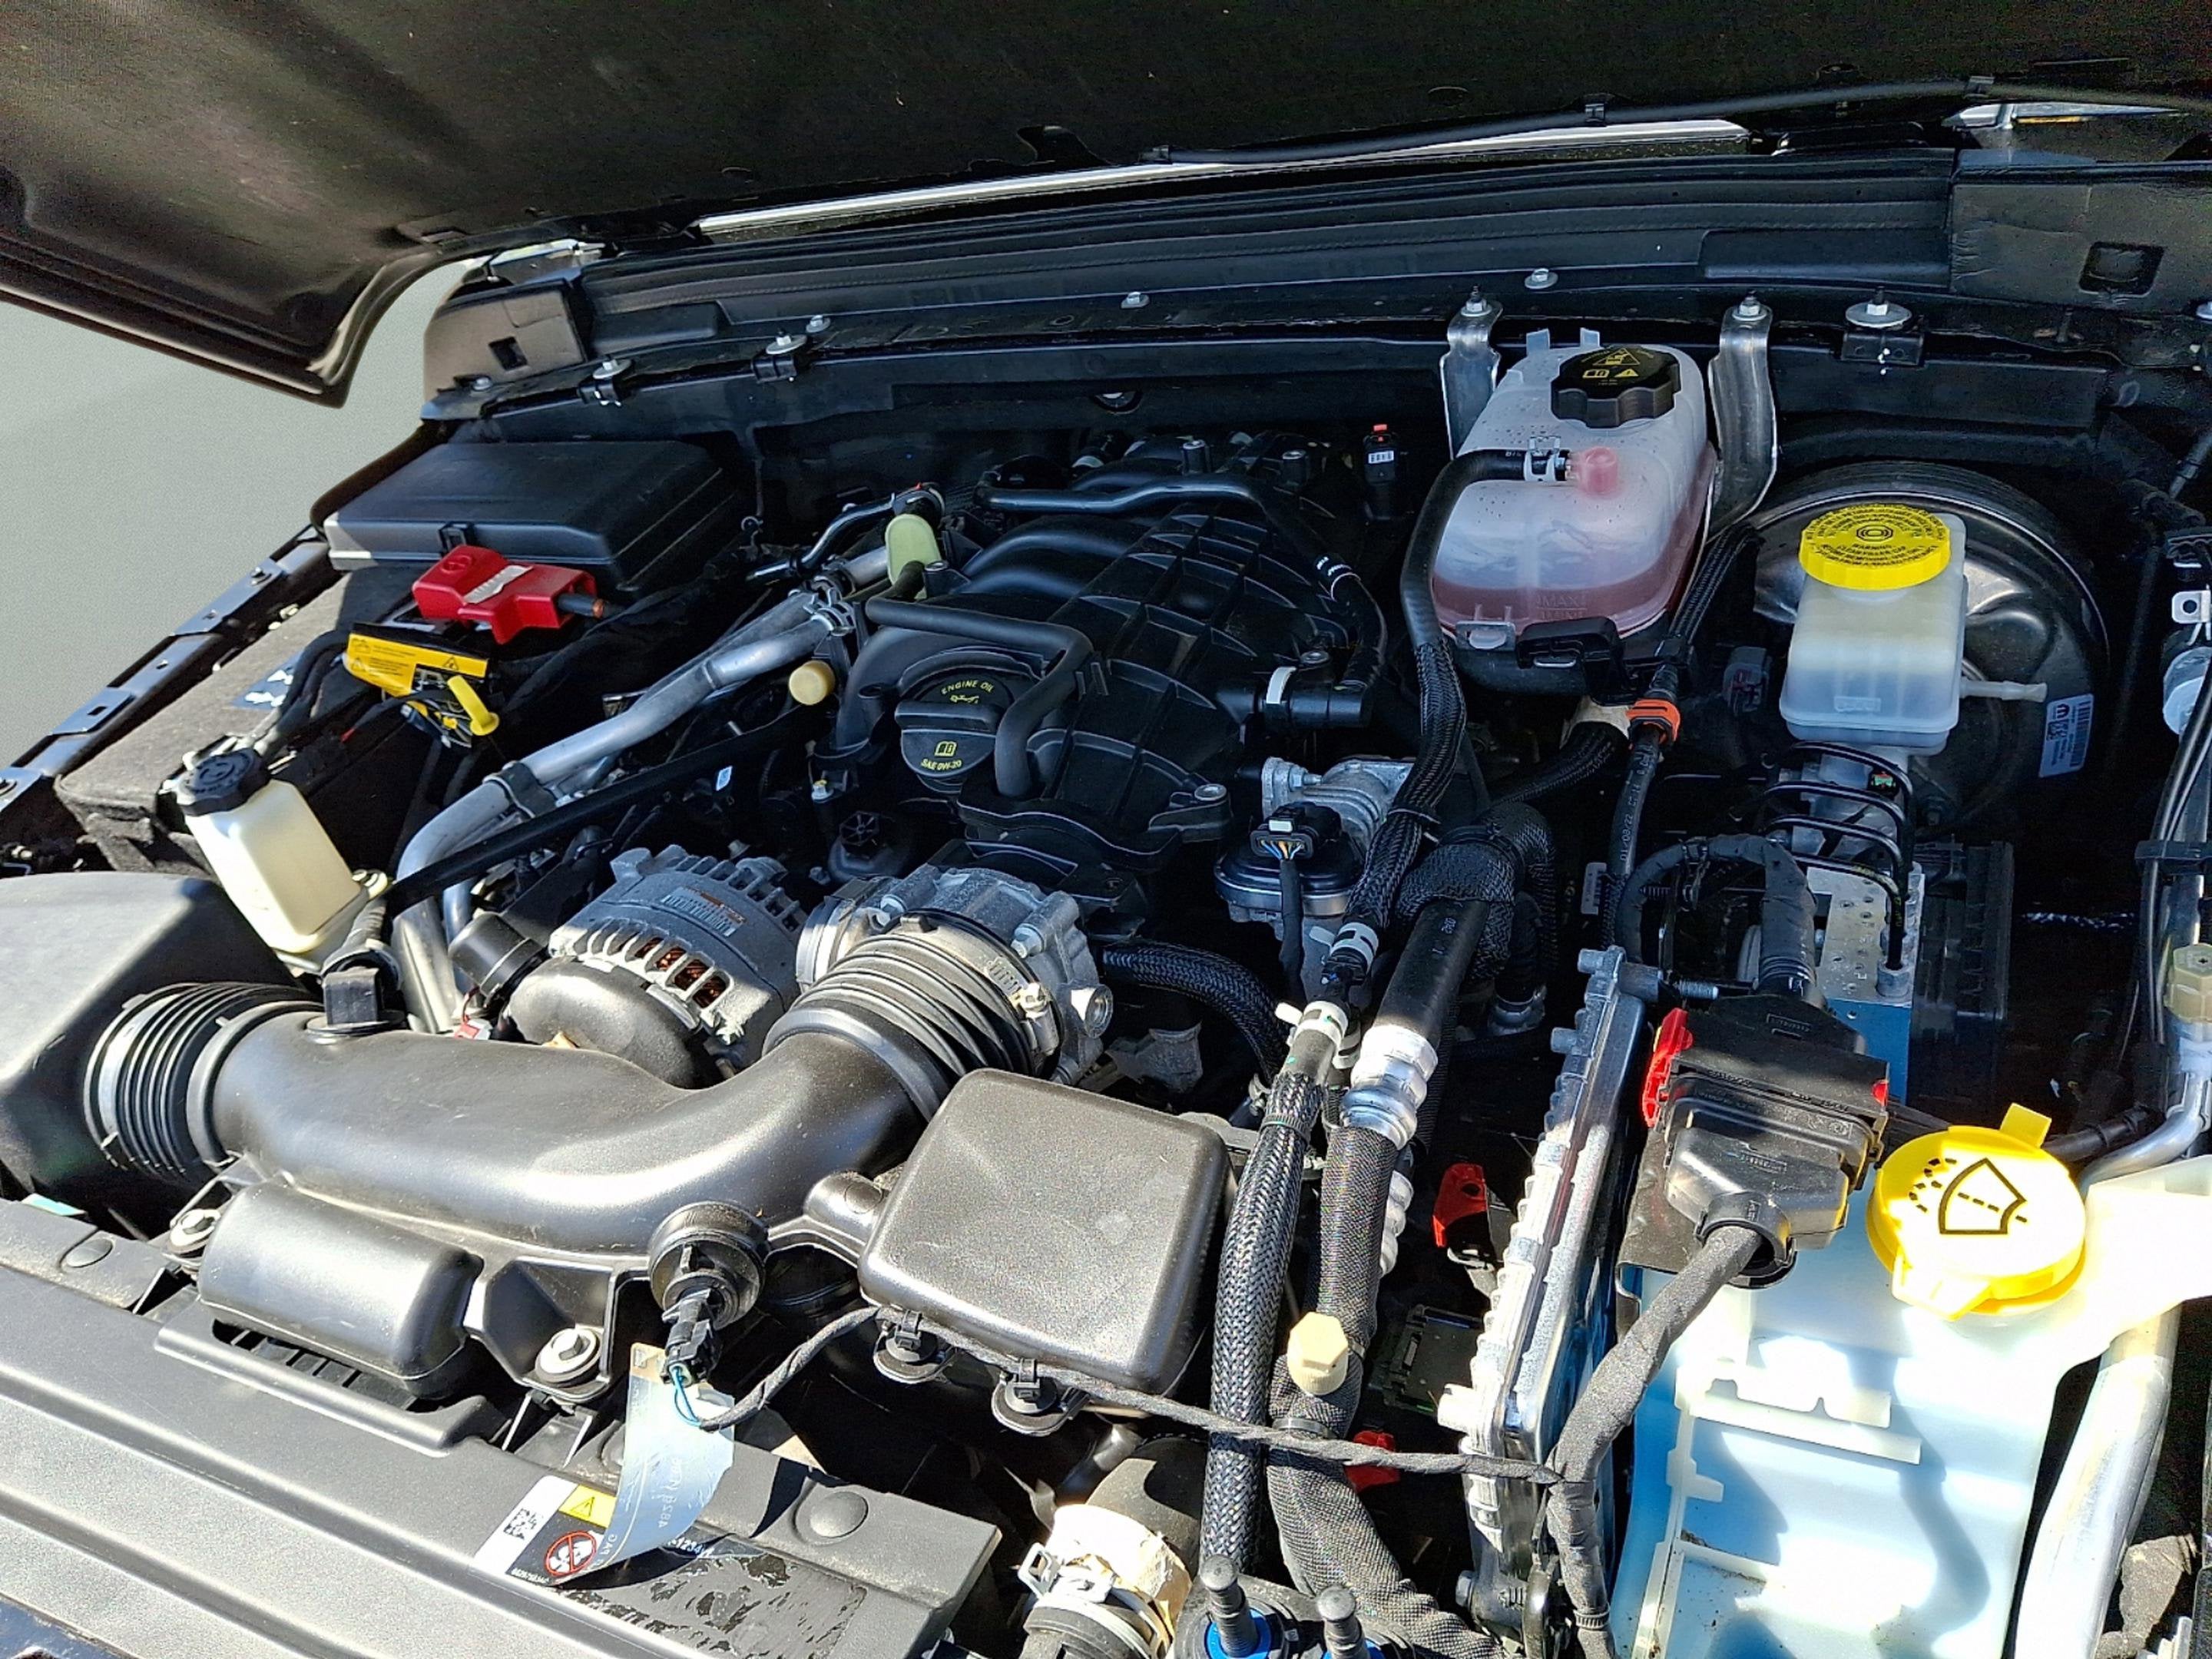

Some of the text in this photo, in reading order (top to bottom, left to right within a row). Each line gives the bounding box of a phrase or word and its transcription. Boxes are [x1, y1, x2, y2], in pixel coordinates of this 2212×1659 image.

[940, 680, 995, 694] ENGINE OIL
[921, 758, 937, 770] SAE
